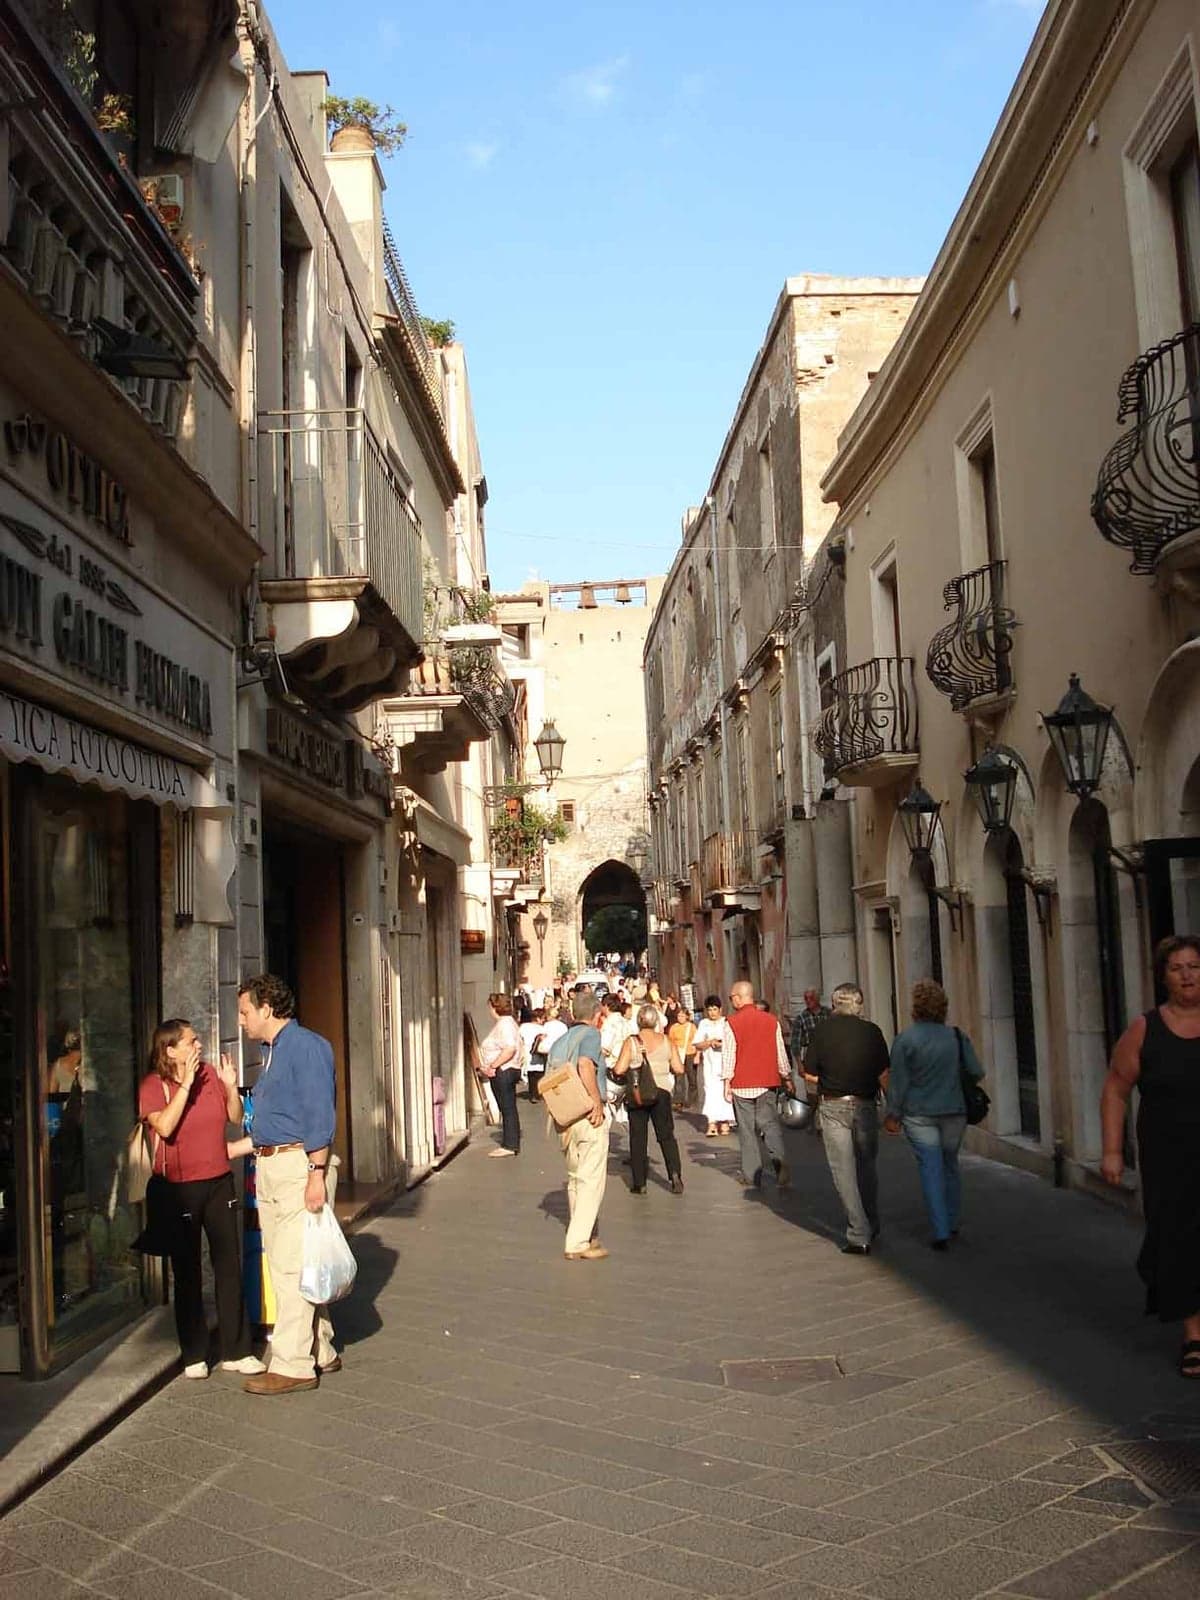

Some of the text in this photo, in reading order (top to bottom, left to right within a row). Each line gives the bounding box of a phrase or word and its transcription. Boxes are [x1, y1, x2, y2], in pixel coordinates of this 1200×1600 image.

[47, 433, 135, 547] OTTICA
[0, 700, 185, 796] TICA FOTOOTTICA
